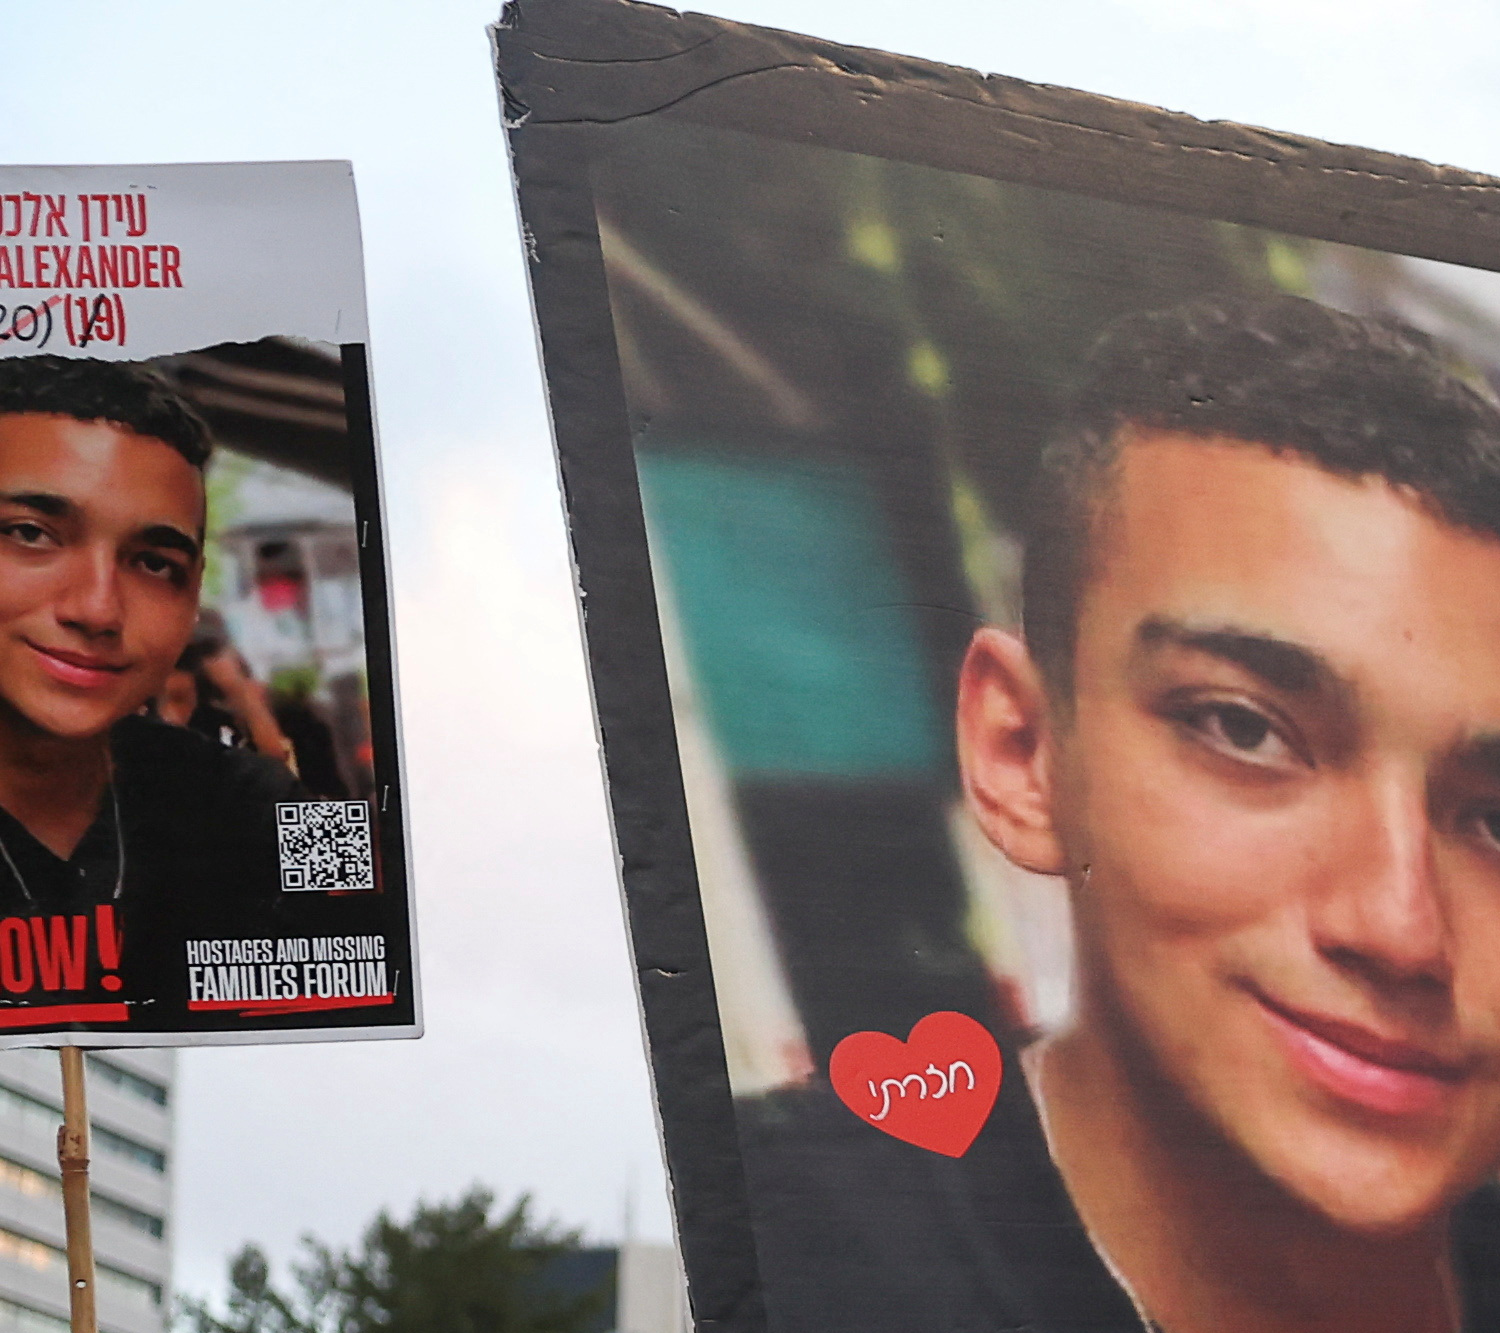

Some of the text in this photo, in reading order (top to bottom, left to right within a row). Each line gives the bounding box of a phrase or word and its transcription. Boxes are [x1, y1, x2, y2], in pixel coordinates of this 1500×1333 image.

[78, 193, 148, 242] עידן
[186, 935, 385, 965] HOSTAGES AND MISSING
[189, 960, 388, 1002] FAMILIES FORUM
